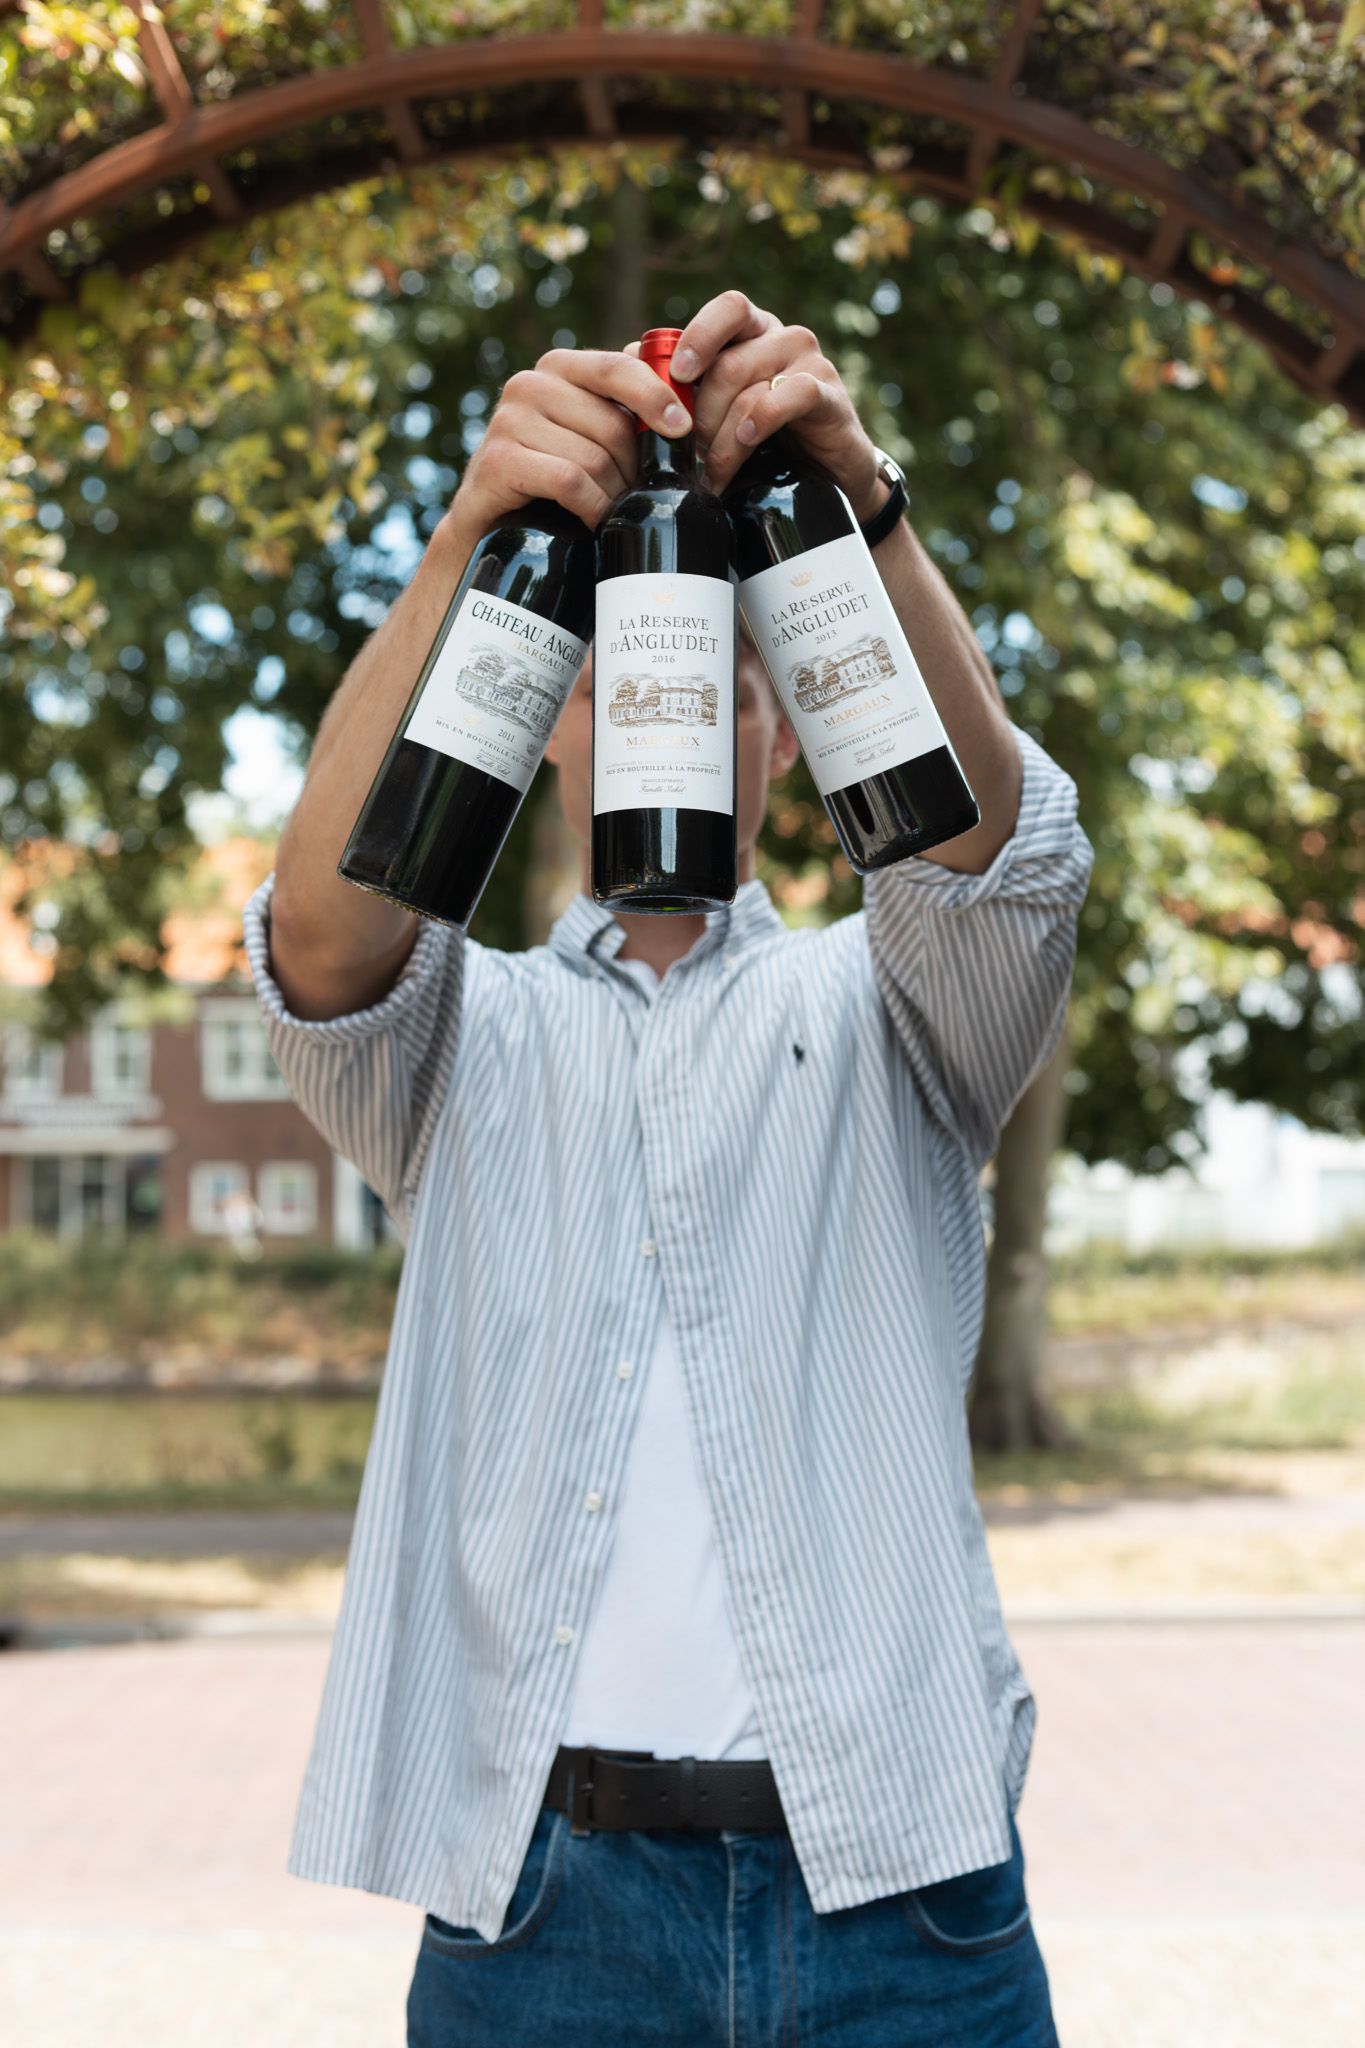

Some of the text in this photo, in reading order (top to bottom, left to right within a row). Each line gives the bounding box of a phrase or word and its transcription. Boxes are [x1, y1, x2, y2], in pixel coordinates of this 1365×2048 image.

[771, 580, 854, 625] LA RESERVE
[472, 600, 543, 643] CHATEAU
[619, 614, 709, 631] LA RESERVE
[771, 593, 871, 649] D'ANGLUDET
[610, 634, 719, 654] D'ANGLUDET
[815, 629, 838, 645] 2013
[651, 655, 676, 663] 2016
[823, 692, 891, 728] MARGAUX
[435, 719, 450, 730] MIS
[453, 726, 465, 736] EN
[467, 732, 510, 757] BOUTEILLE
[497, 728, 515, 743] 2011
[626, 736, 700, 747] MARGUX
[627, 765, 665, 773] BOUTEILLE
